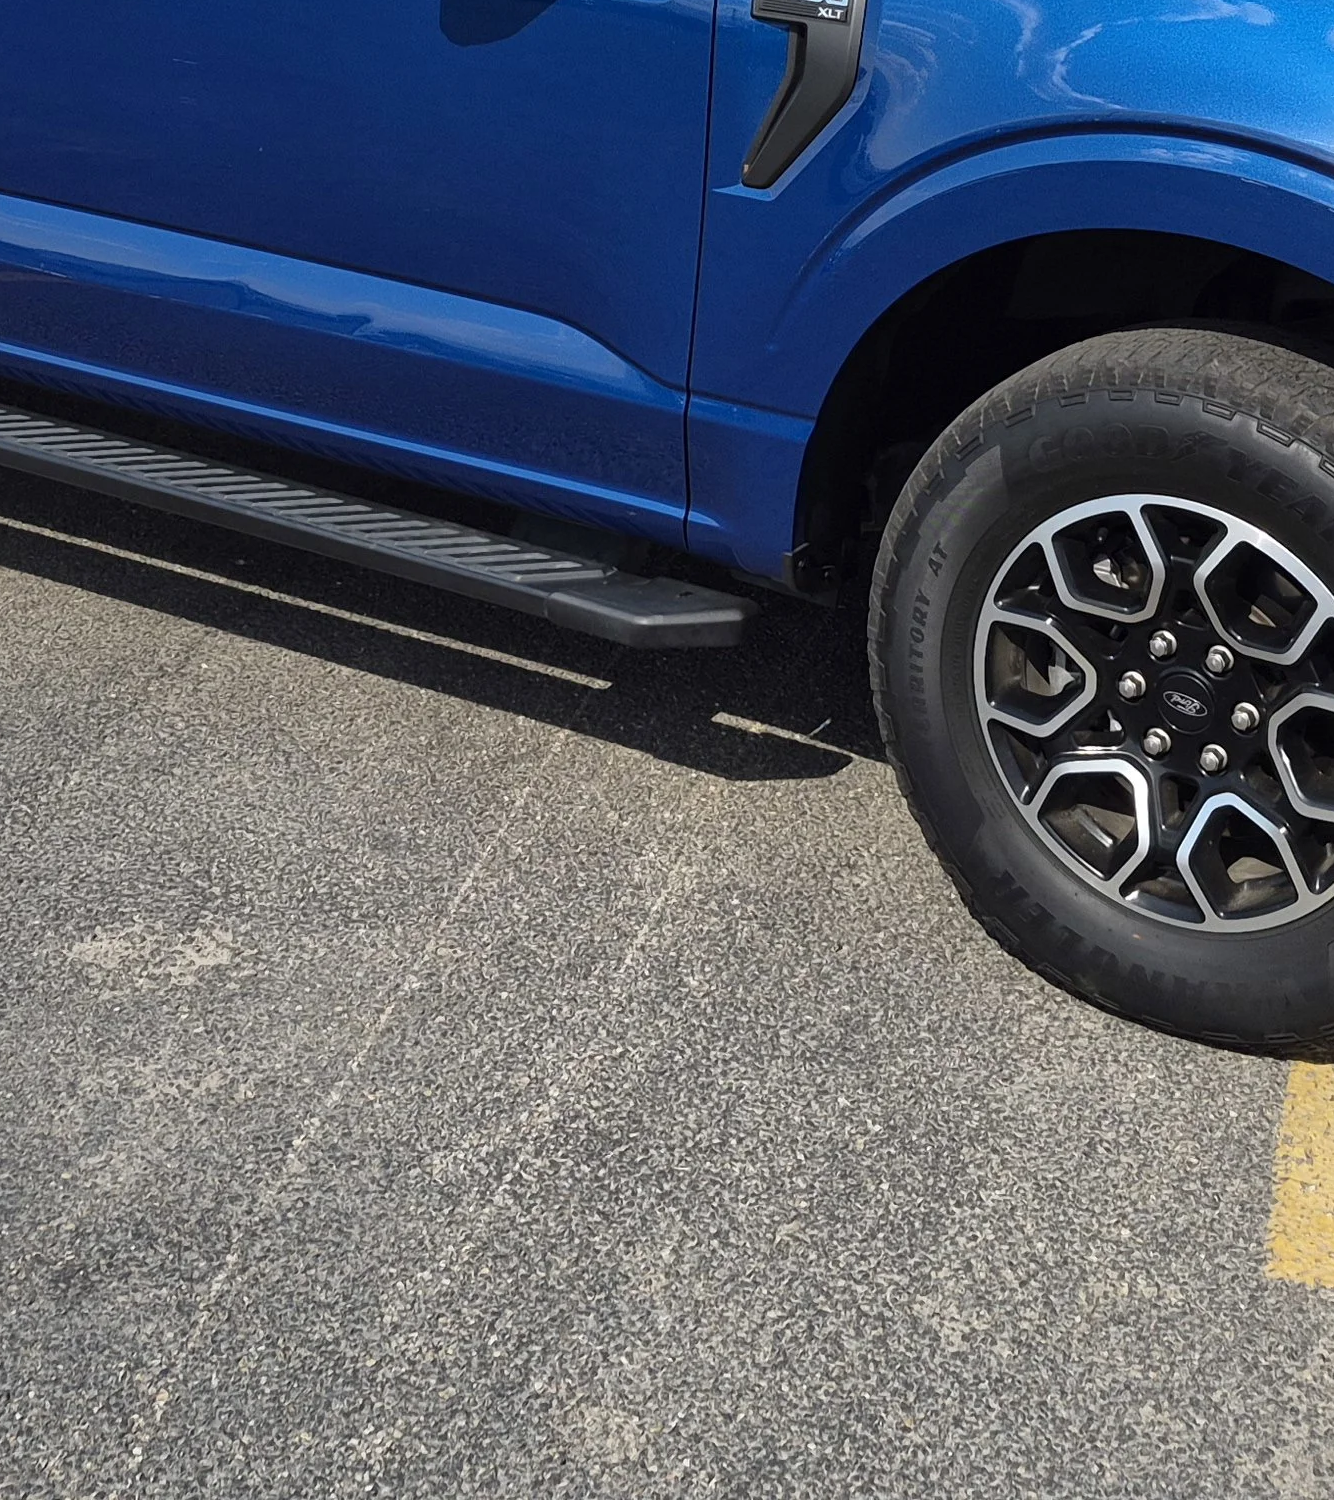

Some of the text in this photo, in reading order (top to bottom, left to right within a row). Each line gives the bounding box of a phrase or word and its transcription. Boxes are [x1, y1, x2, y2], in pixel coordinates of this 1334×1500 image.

[817, 6, 844, 19] XLT
[927, 540, 948, 578] AT
[1170, 693, 1201, 714] Ford
